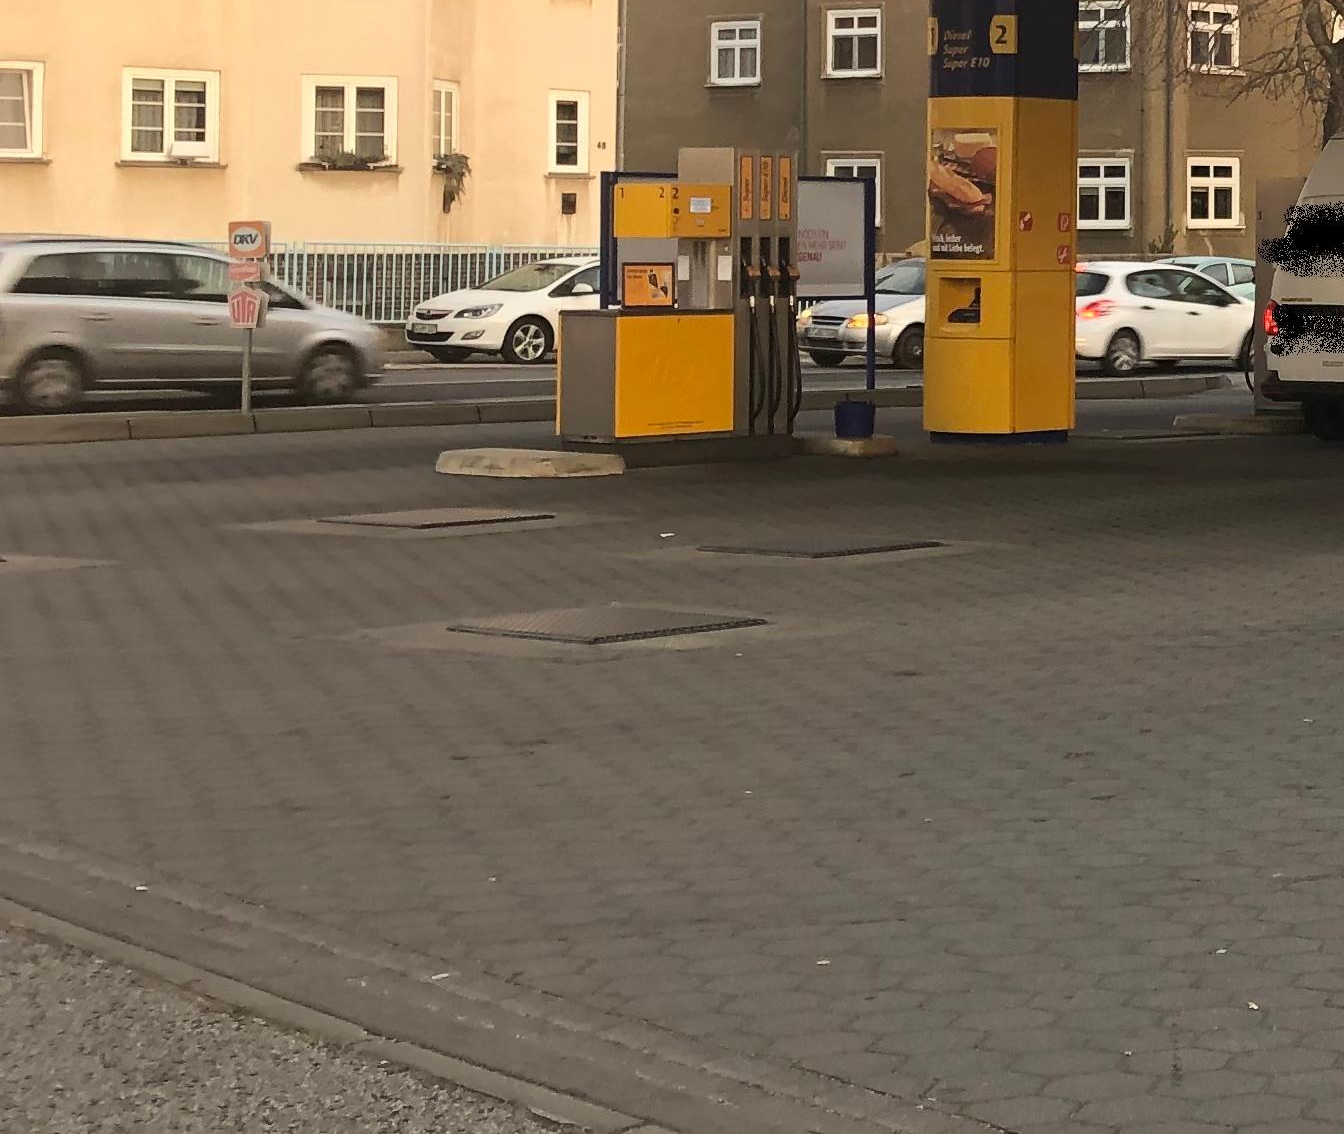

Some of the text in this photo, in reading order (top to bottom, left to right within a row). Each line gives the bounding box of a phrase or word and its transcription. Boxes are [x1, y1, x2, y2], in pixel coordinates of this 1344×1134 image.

[943, 28, 972, 41] Diesel
[995, 24, 1007, 44] 2
[943, 44, 969, 57] Super
[943, 57, 991, 71] Super E10
[620, 187, 665, 199] 1 2
[671, 187, 679, 200] 2
[233, 233, 258, 245] DKV
